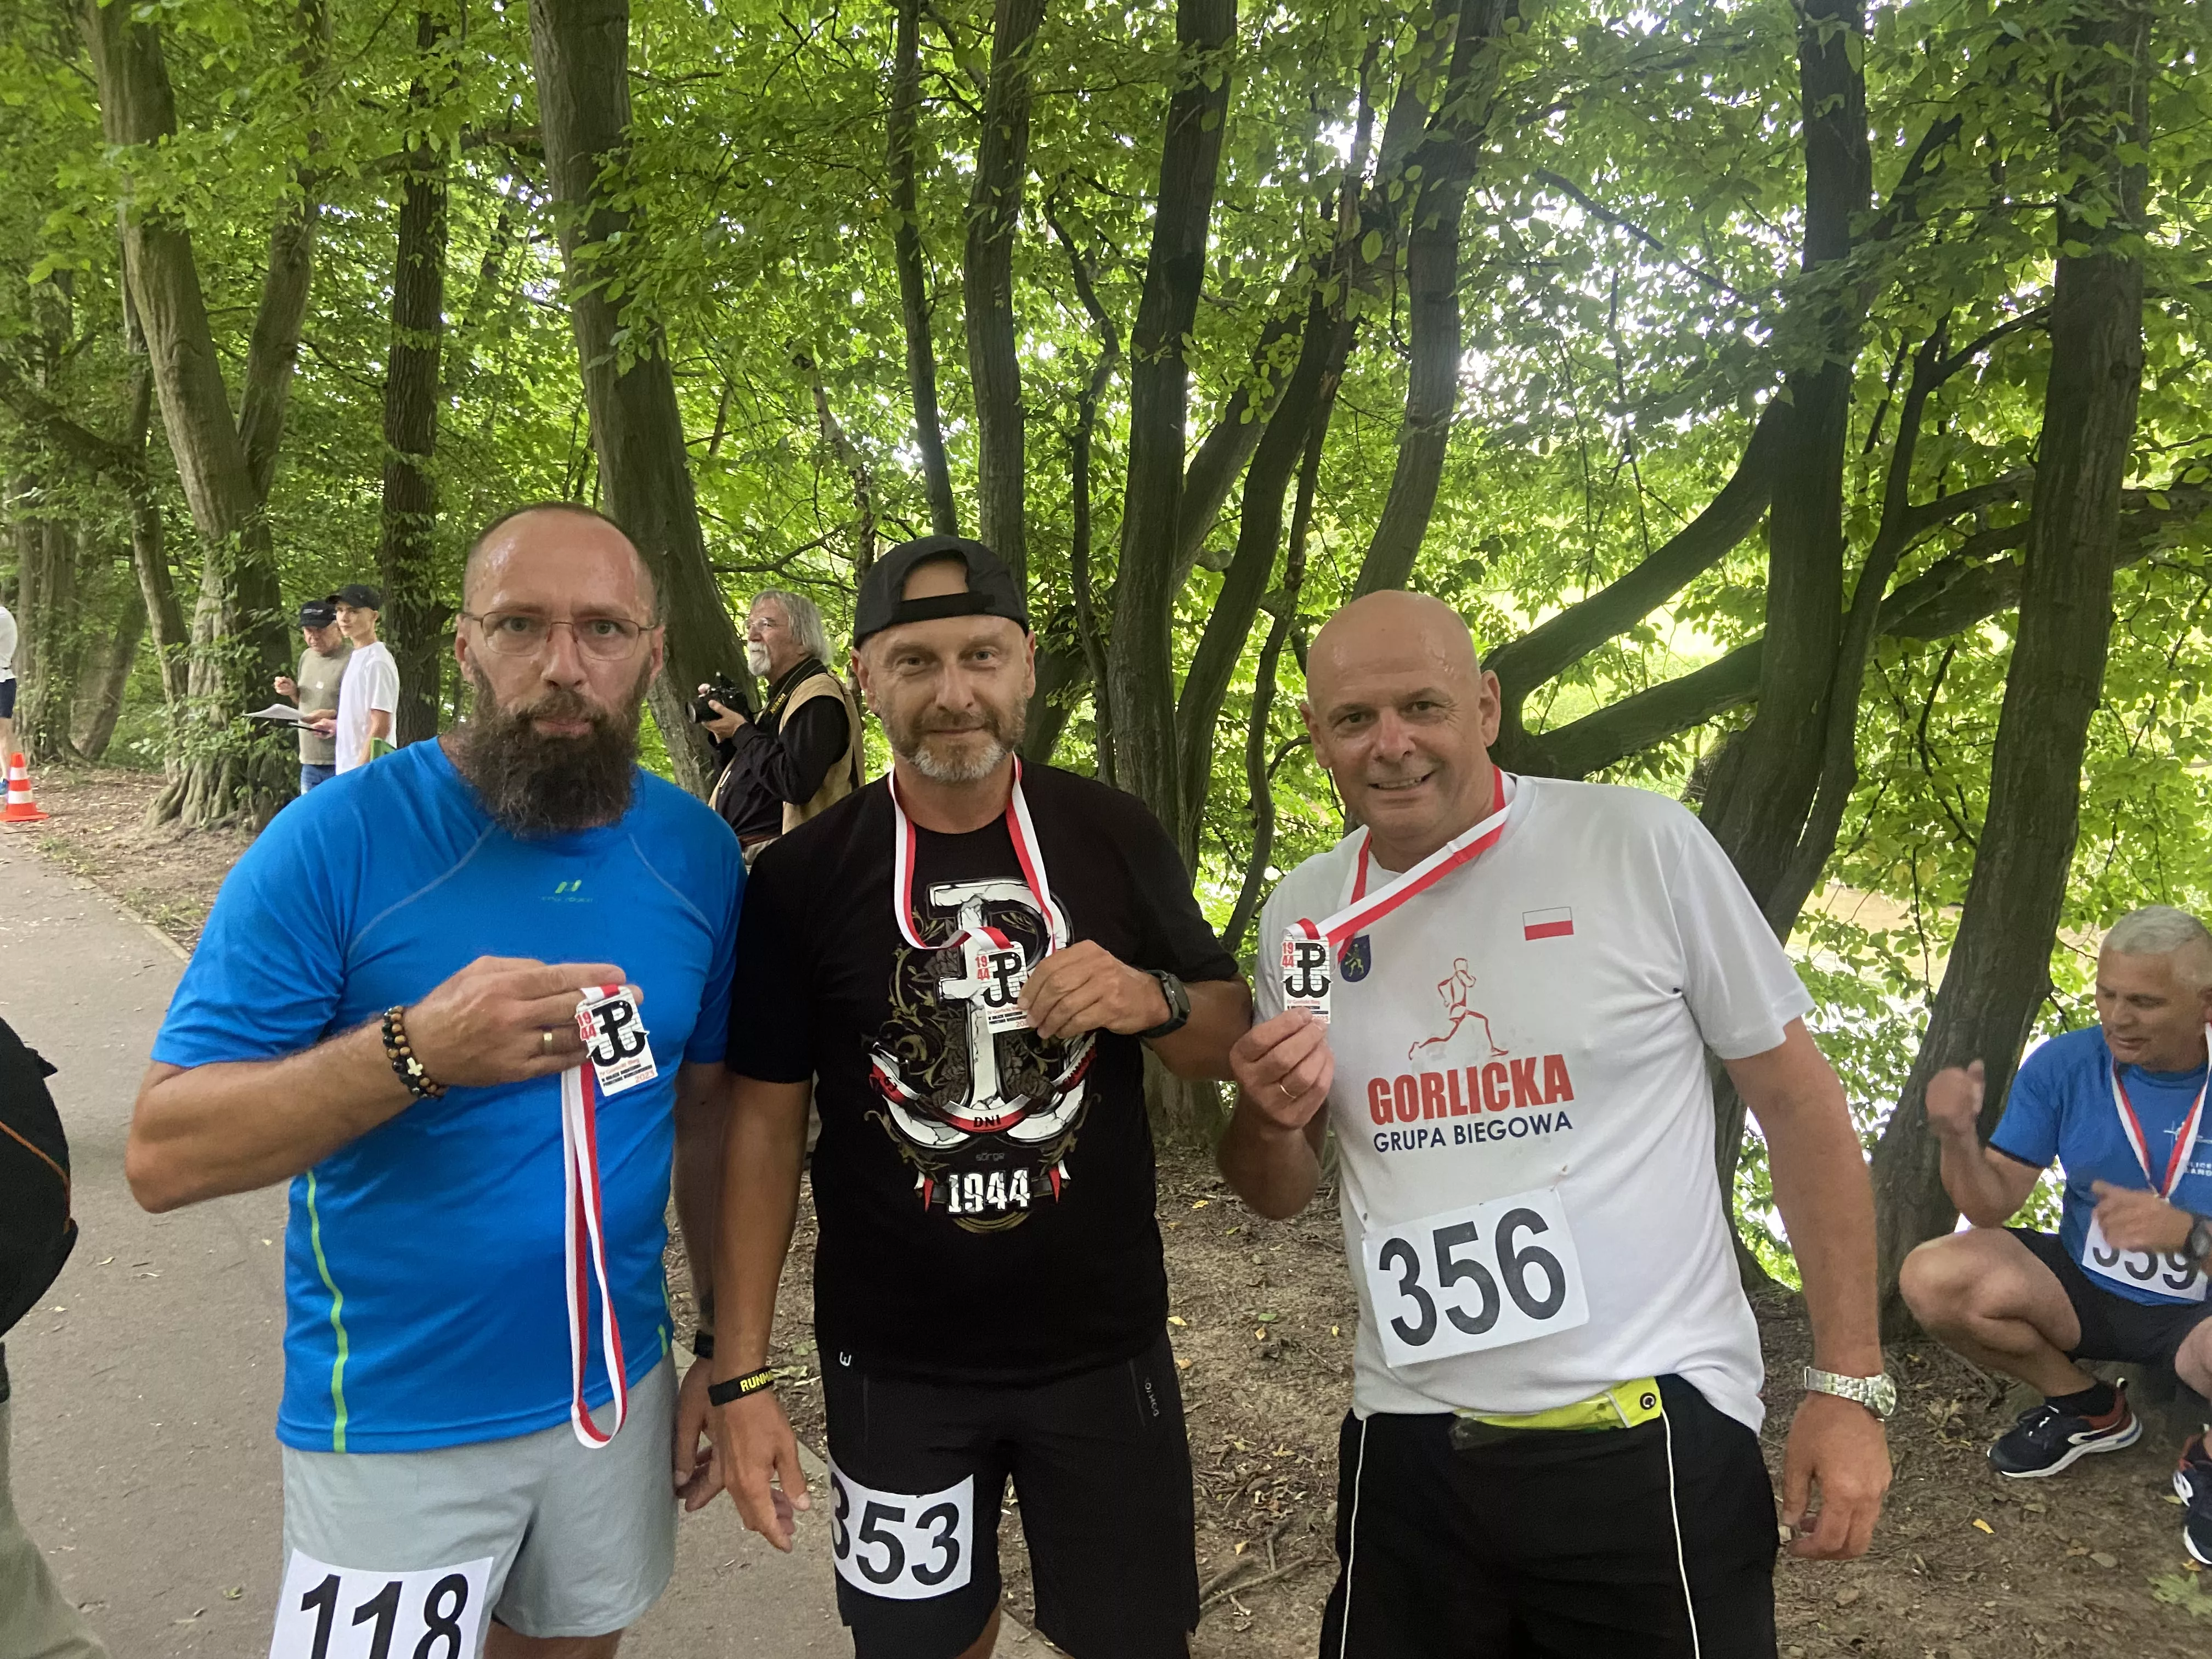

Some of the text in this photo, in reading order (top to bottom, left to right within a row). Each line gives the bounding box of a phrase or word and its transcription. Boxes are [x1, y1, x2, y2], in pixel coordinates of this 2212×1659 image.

[1282, 943, 1294, 954] 19
[975, 955, 988, 968] 19
[1282, 955, 1294, 968] 44
[977, 968, 990, 980] 44
[577, 1011, 591, 1026] 19
[582, 1024, 596, 1040] 44
[1367, 1054, 1574, 1125] GORLICKA
[973, 1114, 1001, 1127] DNI
[1374, 1111, 1573, 1152] GRUPA BIEGOWA
[949, 1170, 1030, 1212] 1944
[1379, 1207, 1565, 1346] 356
[301, 1573, 468, 1659] 118
